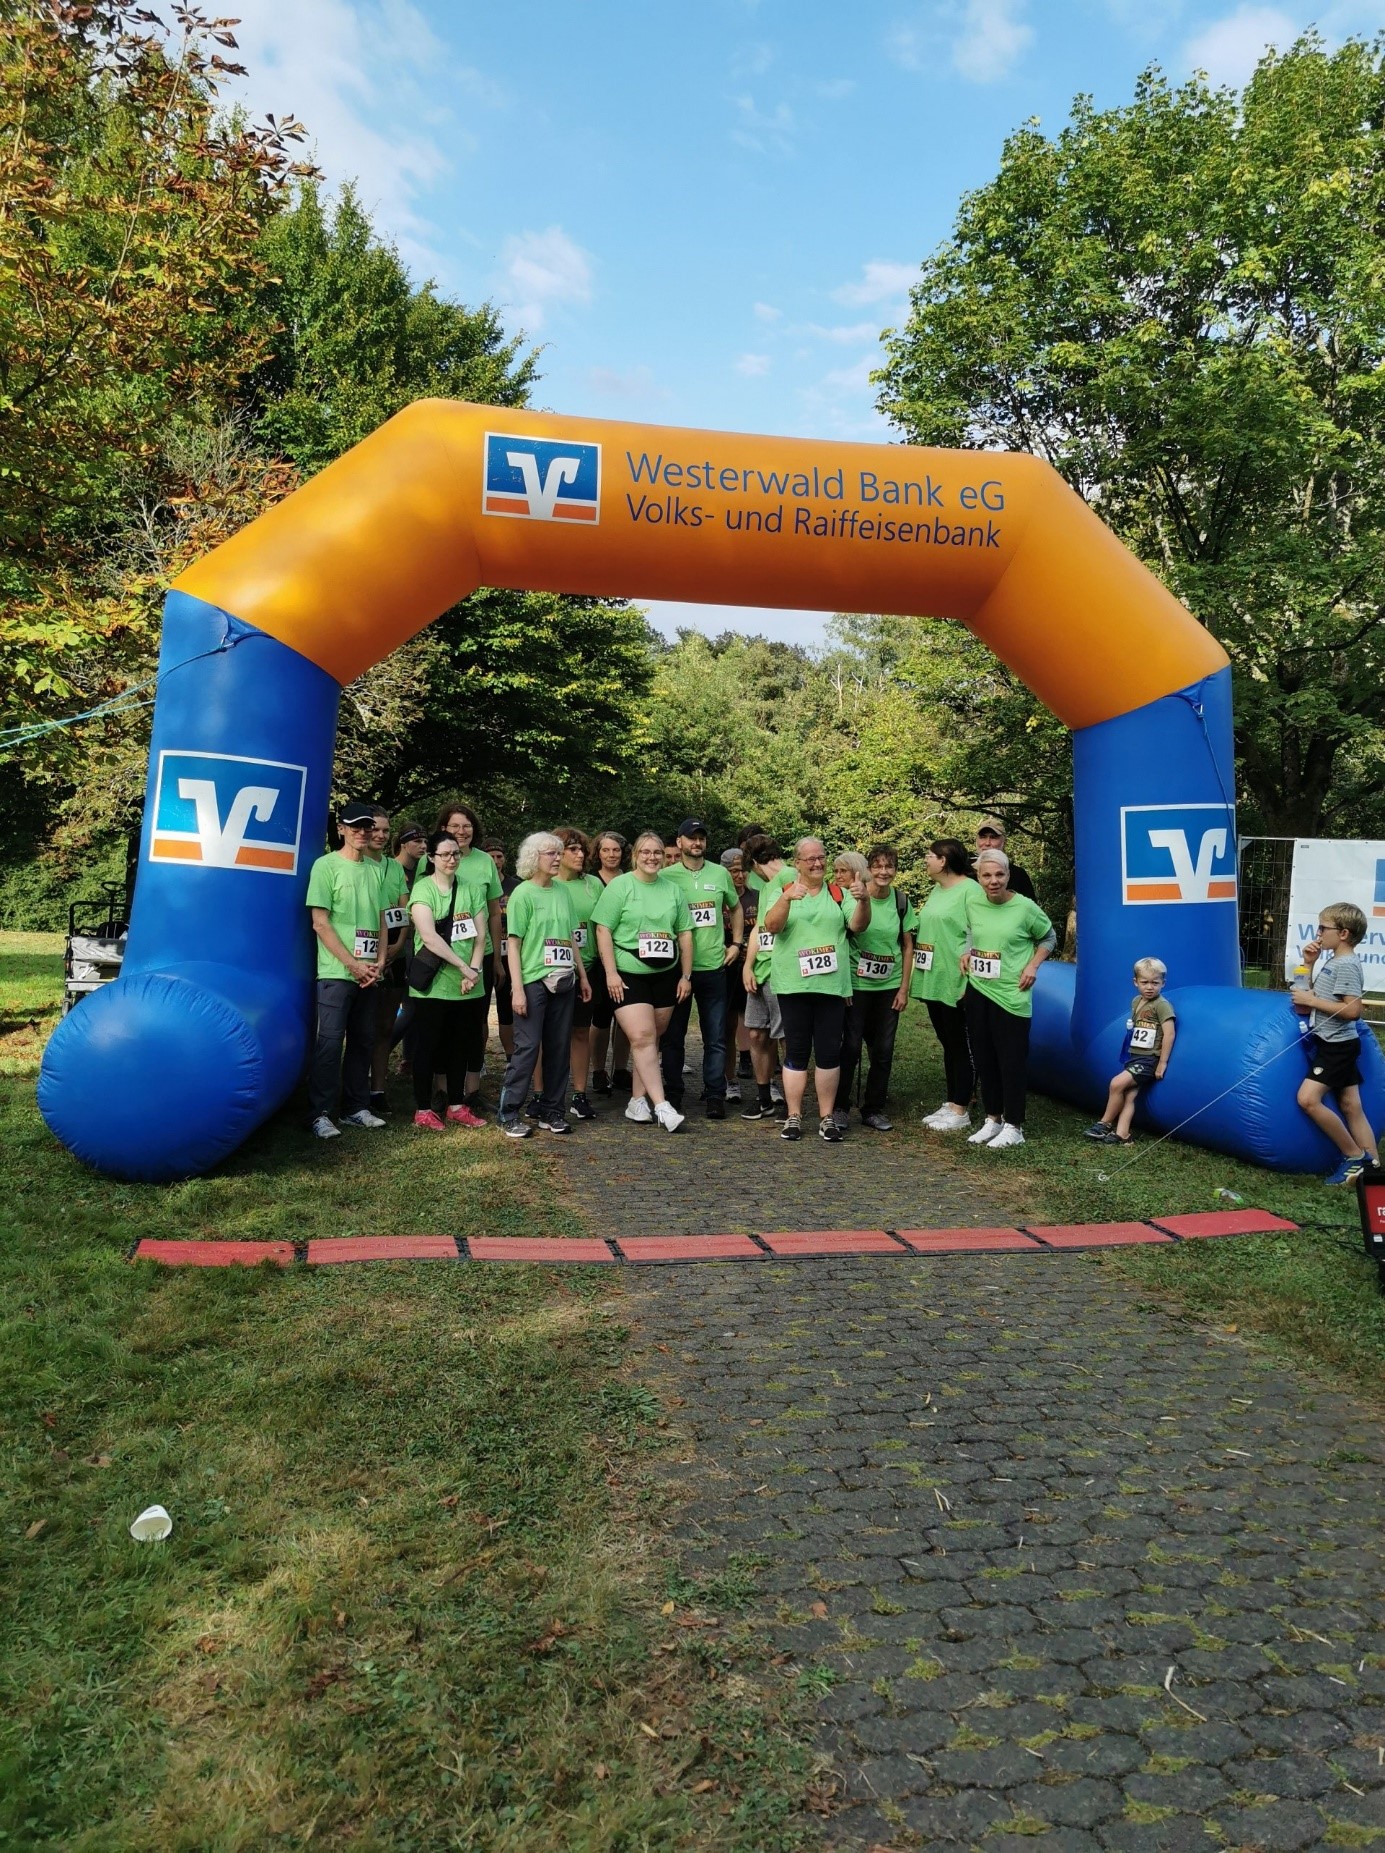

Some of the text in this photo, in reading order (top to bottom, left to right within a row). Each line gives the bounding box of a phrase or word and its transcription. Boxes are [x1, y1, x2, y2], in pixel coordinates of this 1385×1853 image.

[626, 452, 1005, 511] Westerwald Bank eG
[626, 493, 1001, 548] Volks- und Raiffeisenbank
[646, 941, 669, 952] 122
[552, 948, 571, 961] 120
[807, 955, 832, 970] 128
[866, 961, 888, 975] 130
[974, 959, 991, 973] 131
[1134, 1030, 1148, 1042] 42
